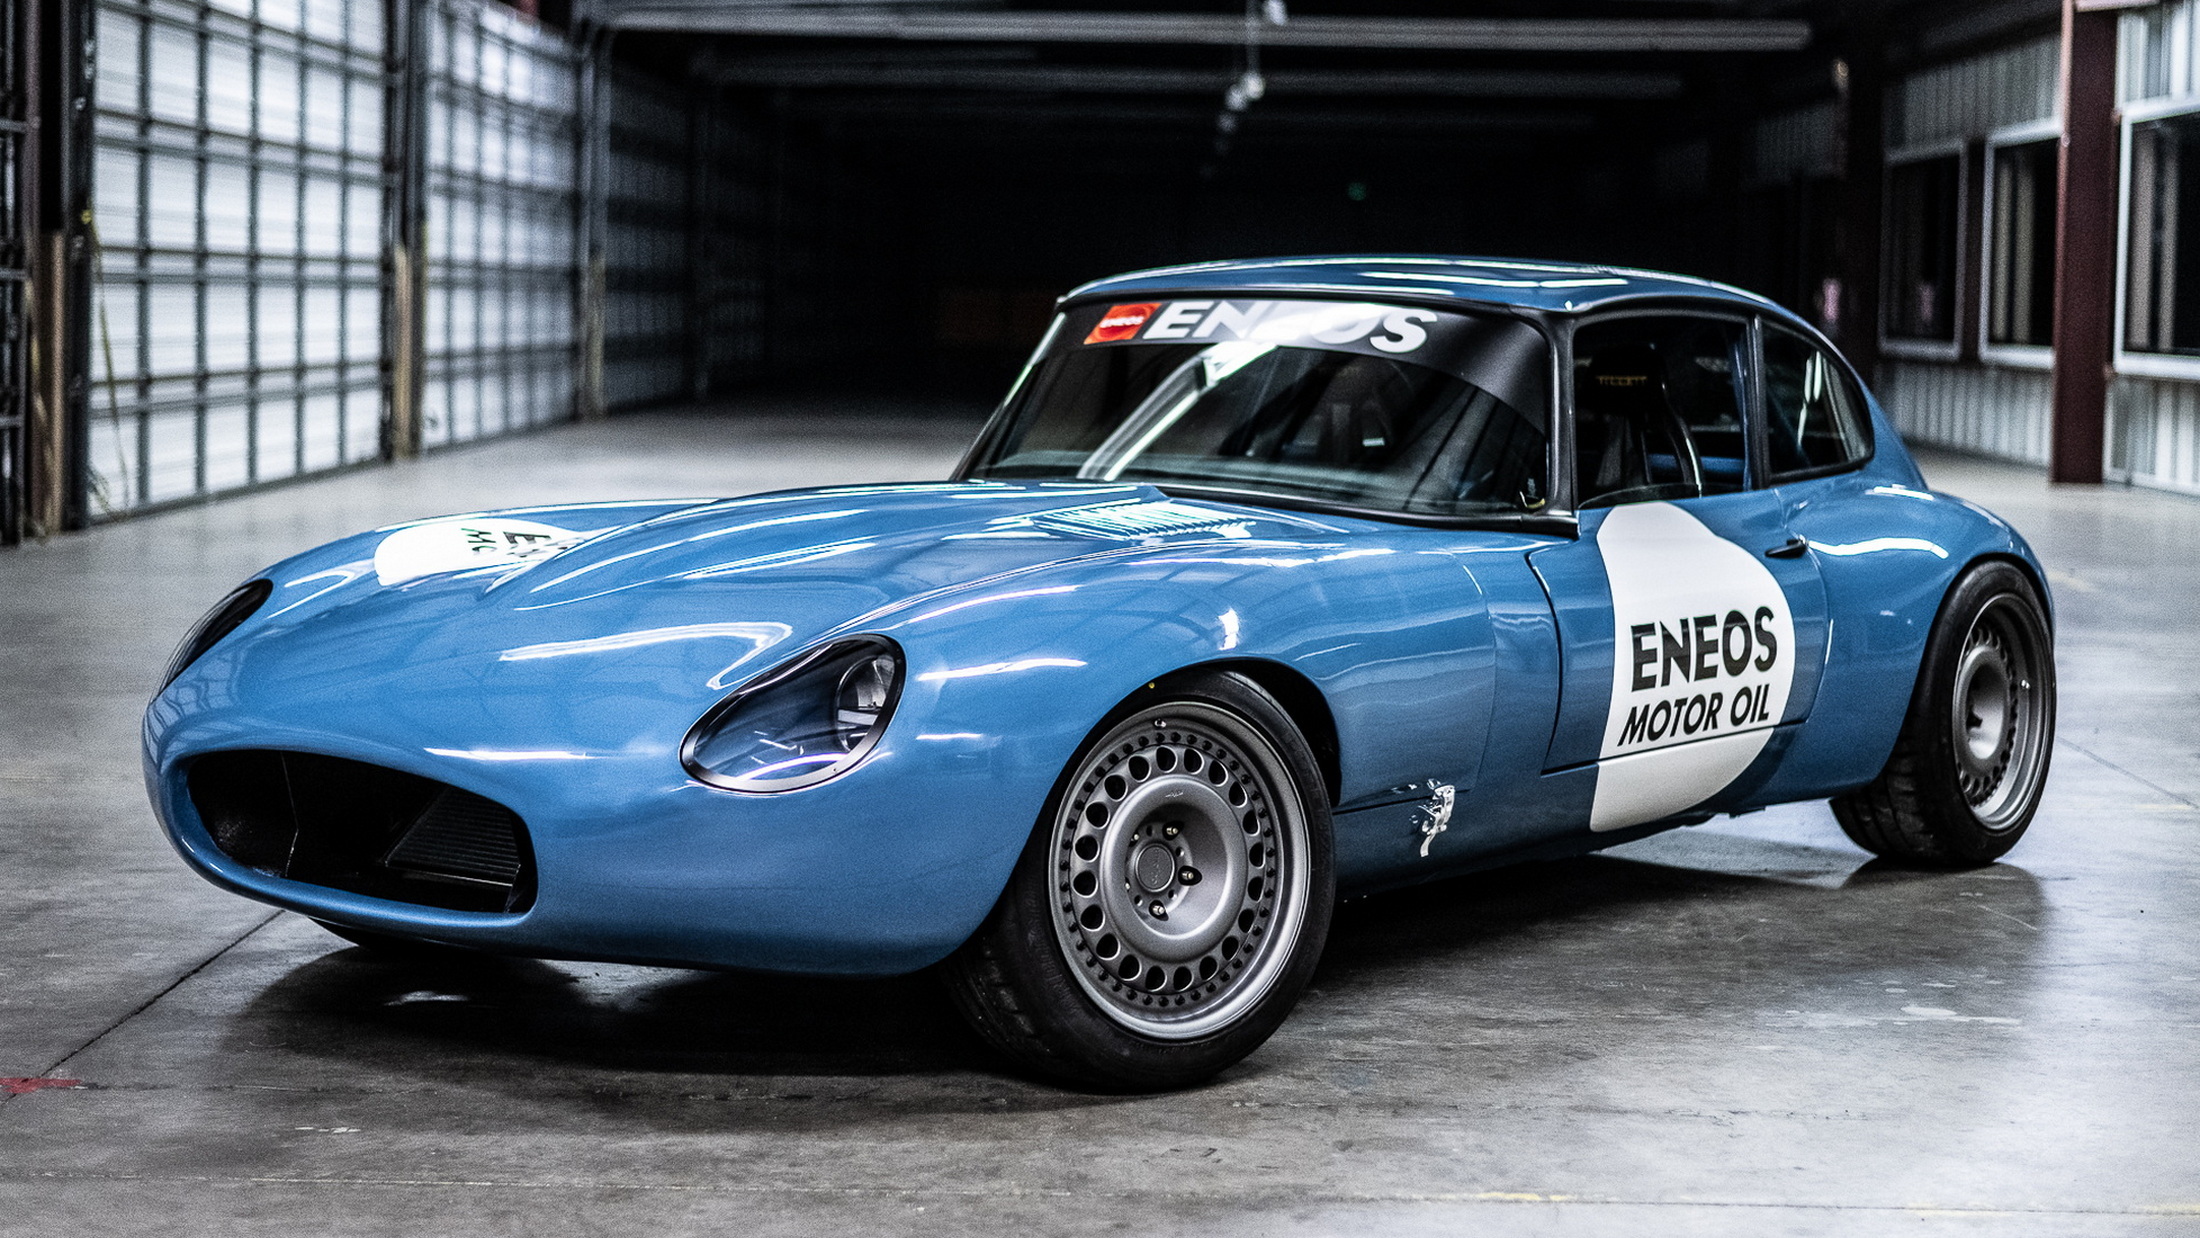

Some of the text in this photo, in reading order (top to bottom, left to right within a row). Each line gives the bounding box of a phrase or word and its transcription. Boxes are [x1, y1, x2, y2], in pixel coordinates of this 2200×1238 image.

[1630, 606, 1777, 693] ENEOS
[1617, 684, 1770, 747] MOTOR OIL
